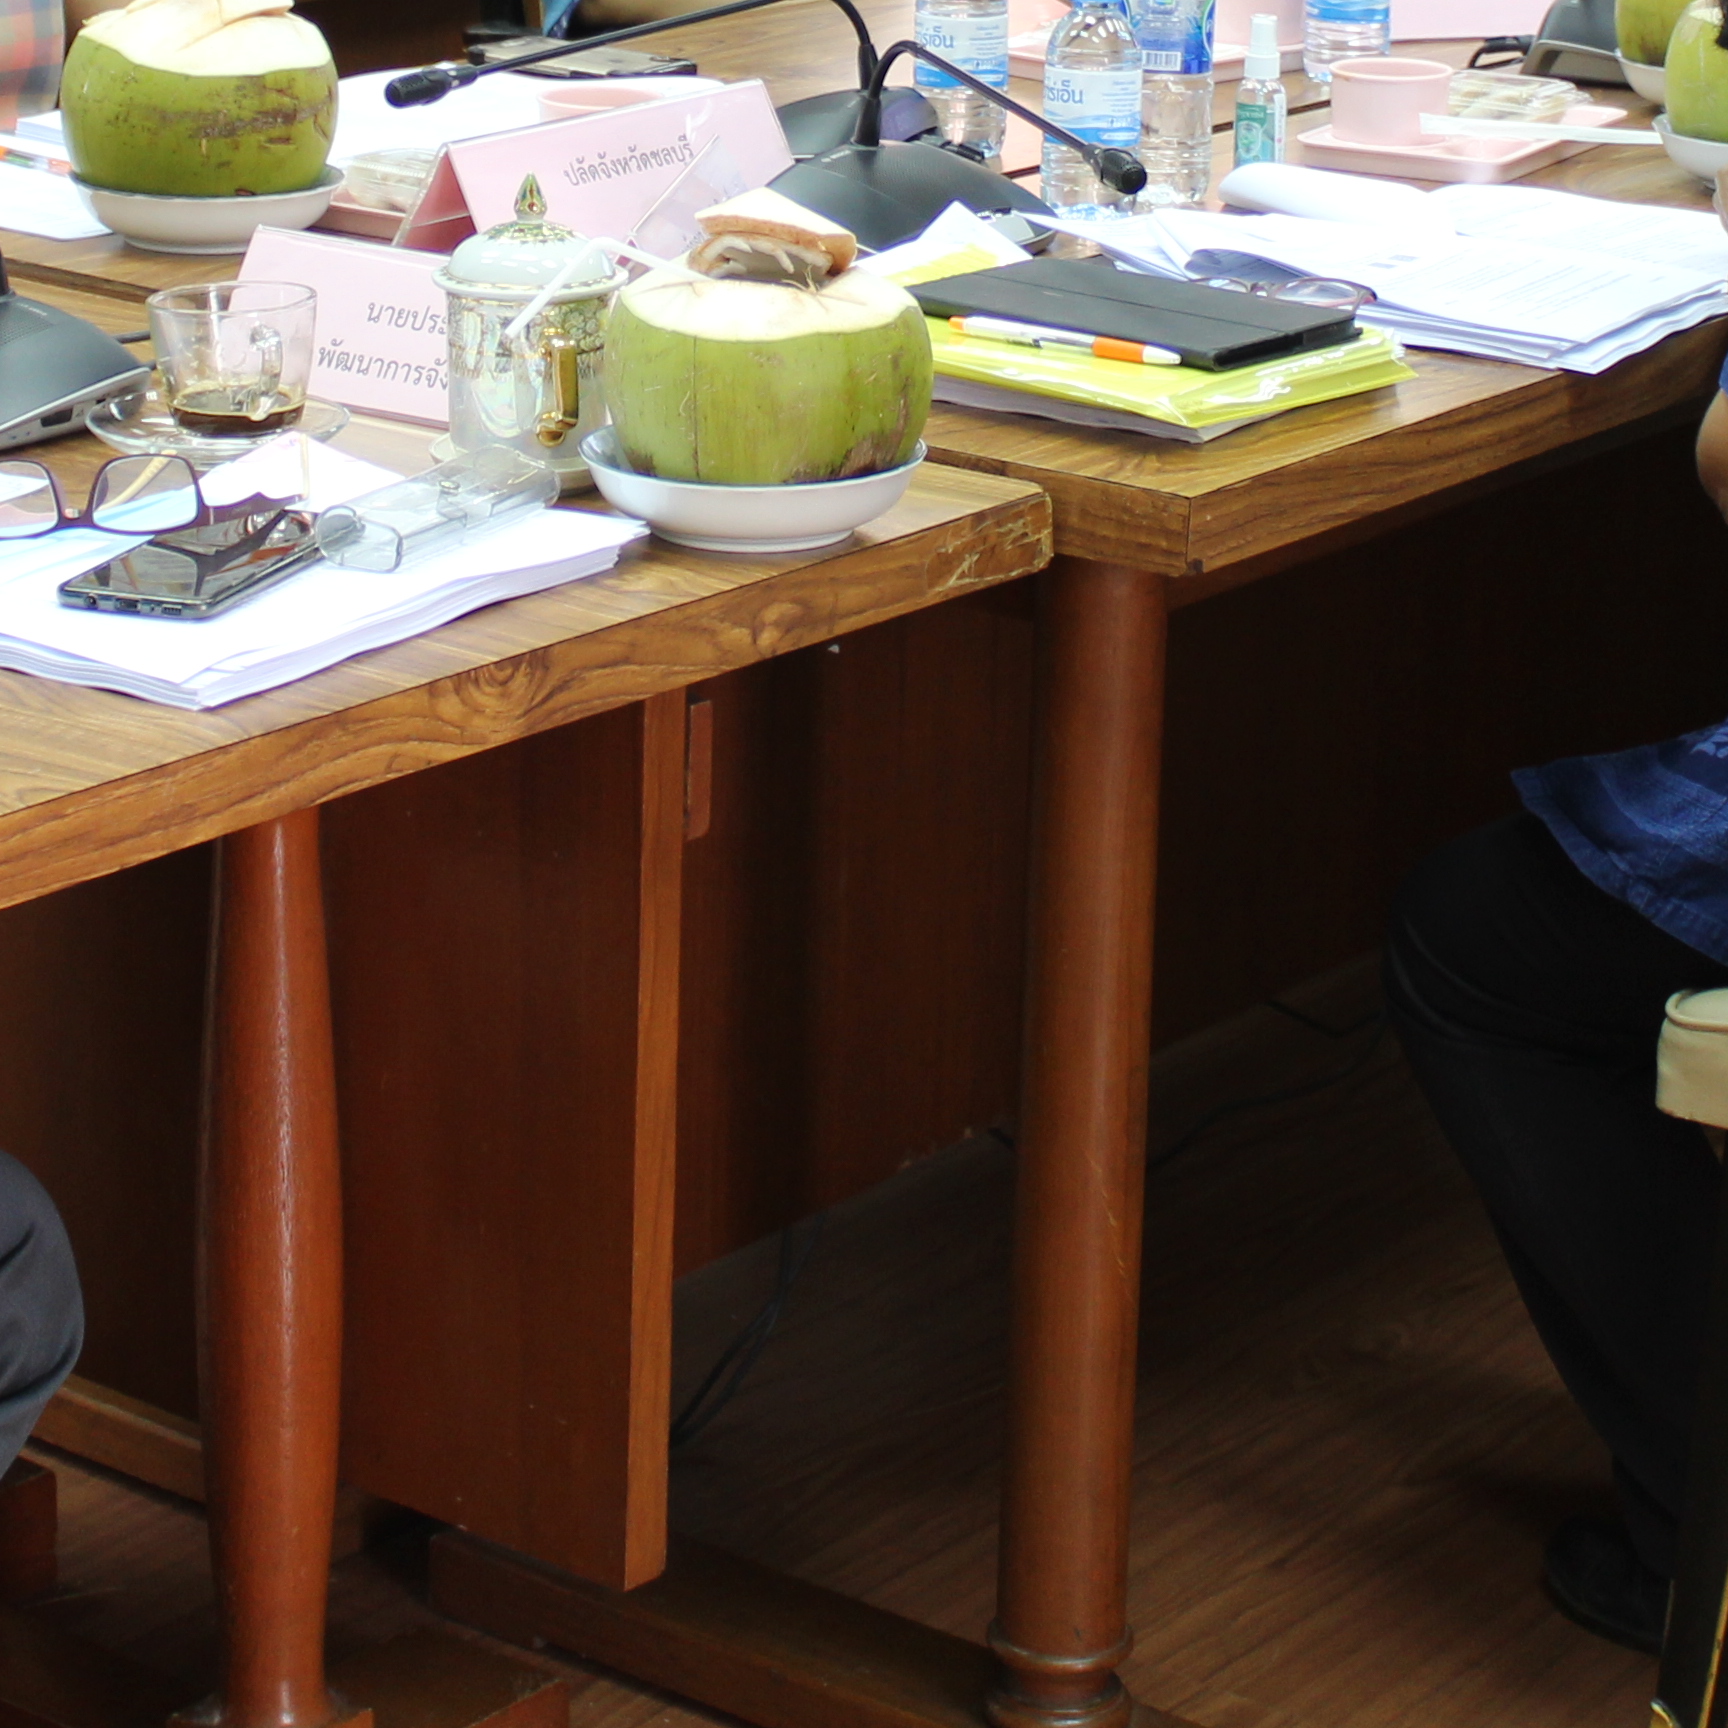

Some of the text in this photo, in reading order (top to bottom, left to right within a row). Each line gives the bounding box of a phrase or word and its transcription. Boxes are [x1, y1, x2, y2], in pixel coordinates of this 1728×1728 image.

[563, 134, 694, 186] ปลัดจังหวัดชลบุรี
